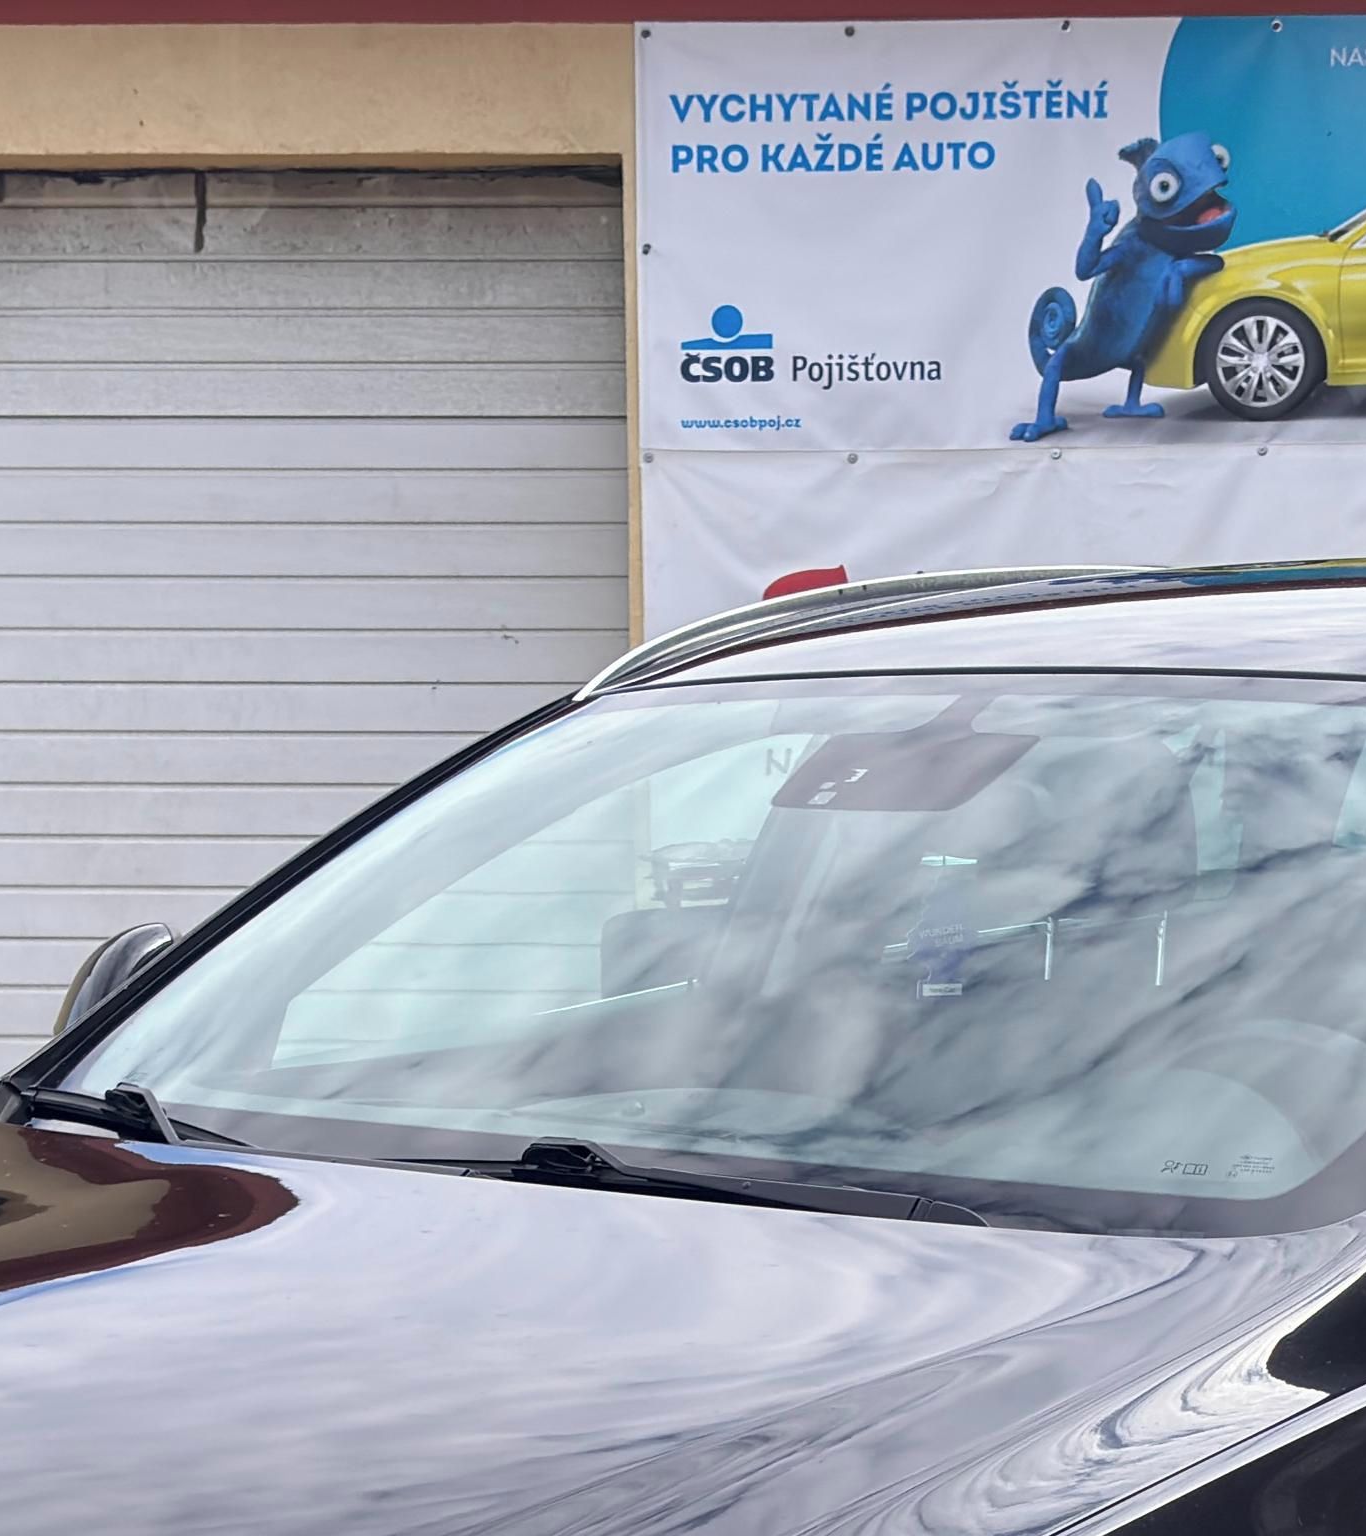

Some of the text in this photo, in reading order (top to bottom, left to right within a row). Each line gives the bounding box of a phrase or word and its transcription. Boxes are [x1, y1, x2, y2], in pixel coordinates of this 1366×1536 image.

[669, 80, 1109, 123] VYCHYTANÉ POJIŠTĚNÍ
[671, 133, 996, 173] PRO KAŽDÉ AUTO
[680, 352, 942, 390] ČSOB Pojišťovna
[681, 415, 802, 431] www.csobpoj.cz
